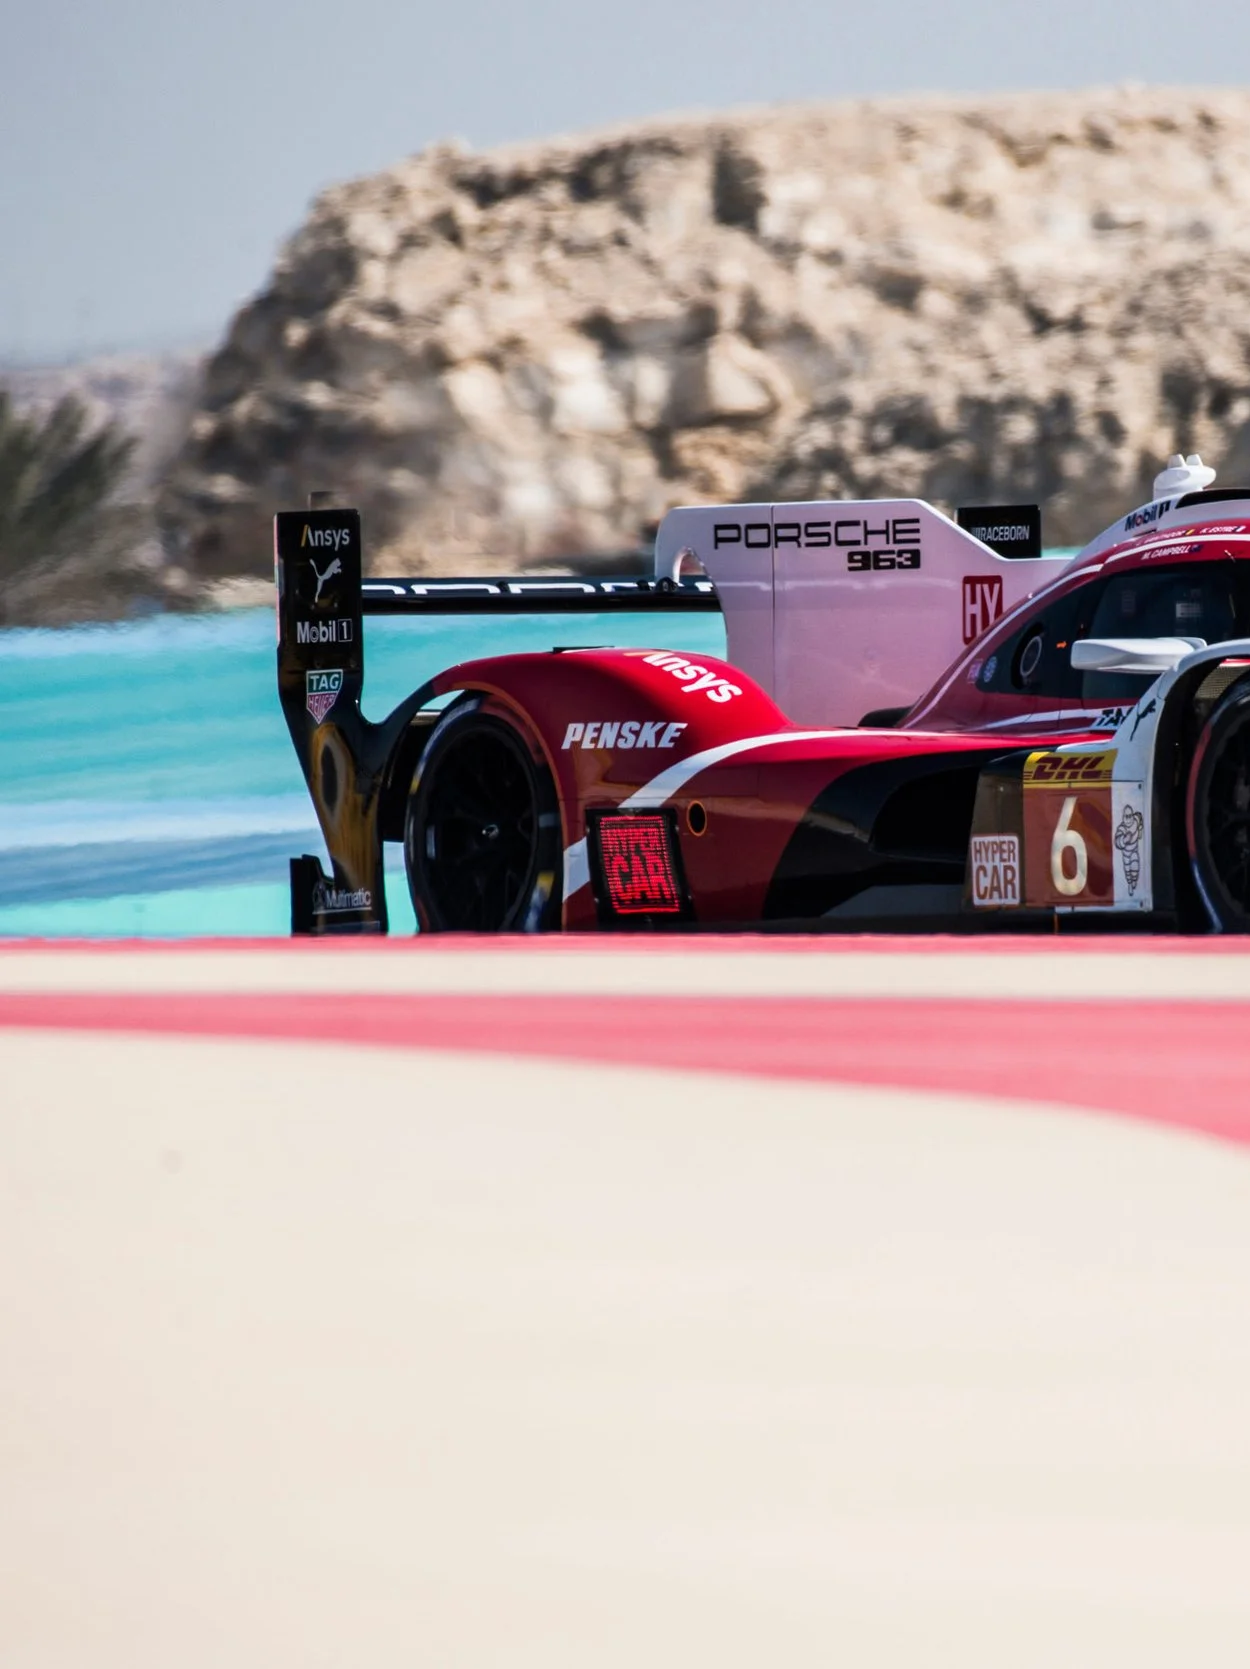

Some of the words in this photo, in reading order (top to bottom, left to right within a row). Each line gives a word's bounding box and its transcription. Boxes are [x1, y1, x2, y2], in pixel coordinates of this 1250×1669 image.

[1125, 504, 1158, 531] Mobil
[301, 524, 350, 551] Ansys
[713, 519, 921, 549] PORSCHE
[980, 525, 1030, 541] RACEBORN
[848, 549, 921, 571] 963
[1150, 545, 1191, 558] CAMPBELL
[965, 584, 1000, 638] HY
[297, 620, 336, 643] Mobil
[310, 674, 339, 691] TAG
[624, 652, 742, 702] Ansys
[308, 694, 335, 714] HEUER
[561, 721, 688, 749] PENSKE
[1032, 756, 1106, 780] DHL
[973, 840, 1016, 863] HYPER
[1052, 796, 1088, 896] 6
[611, 854, 671, 900] CAR
[975, 865, 1017, 899] CAR
[326, 888, 372, 908] Multimatic
